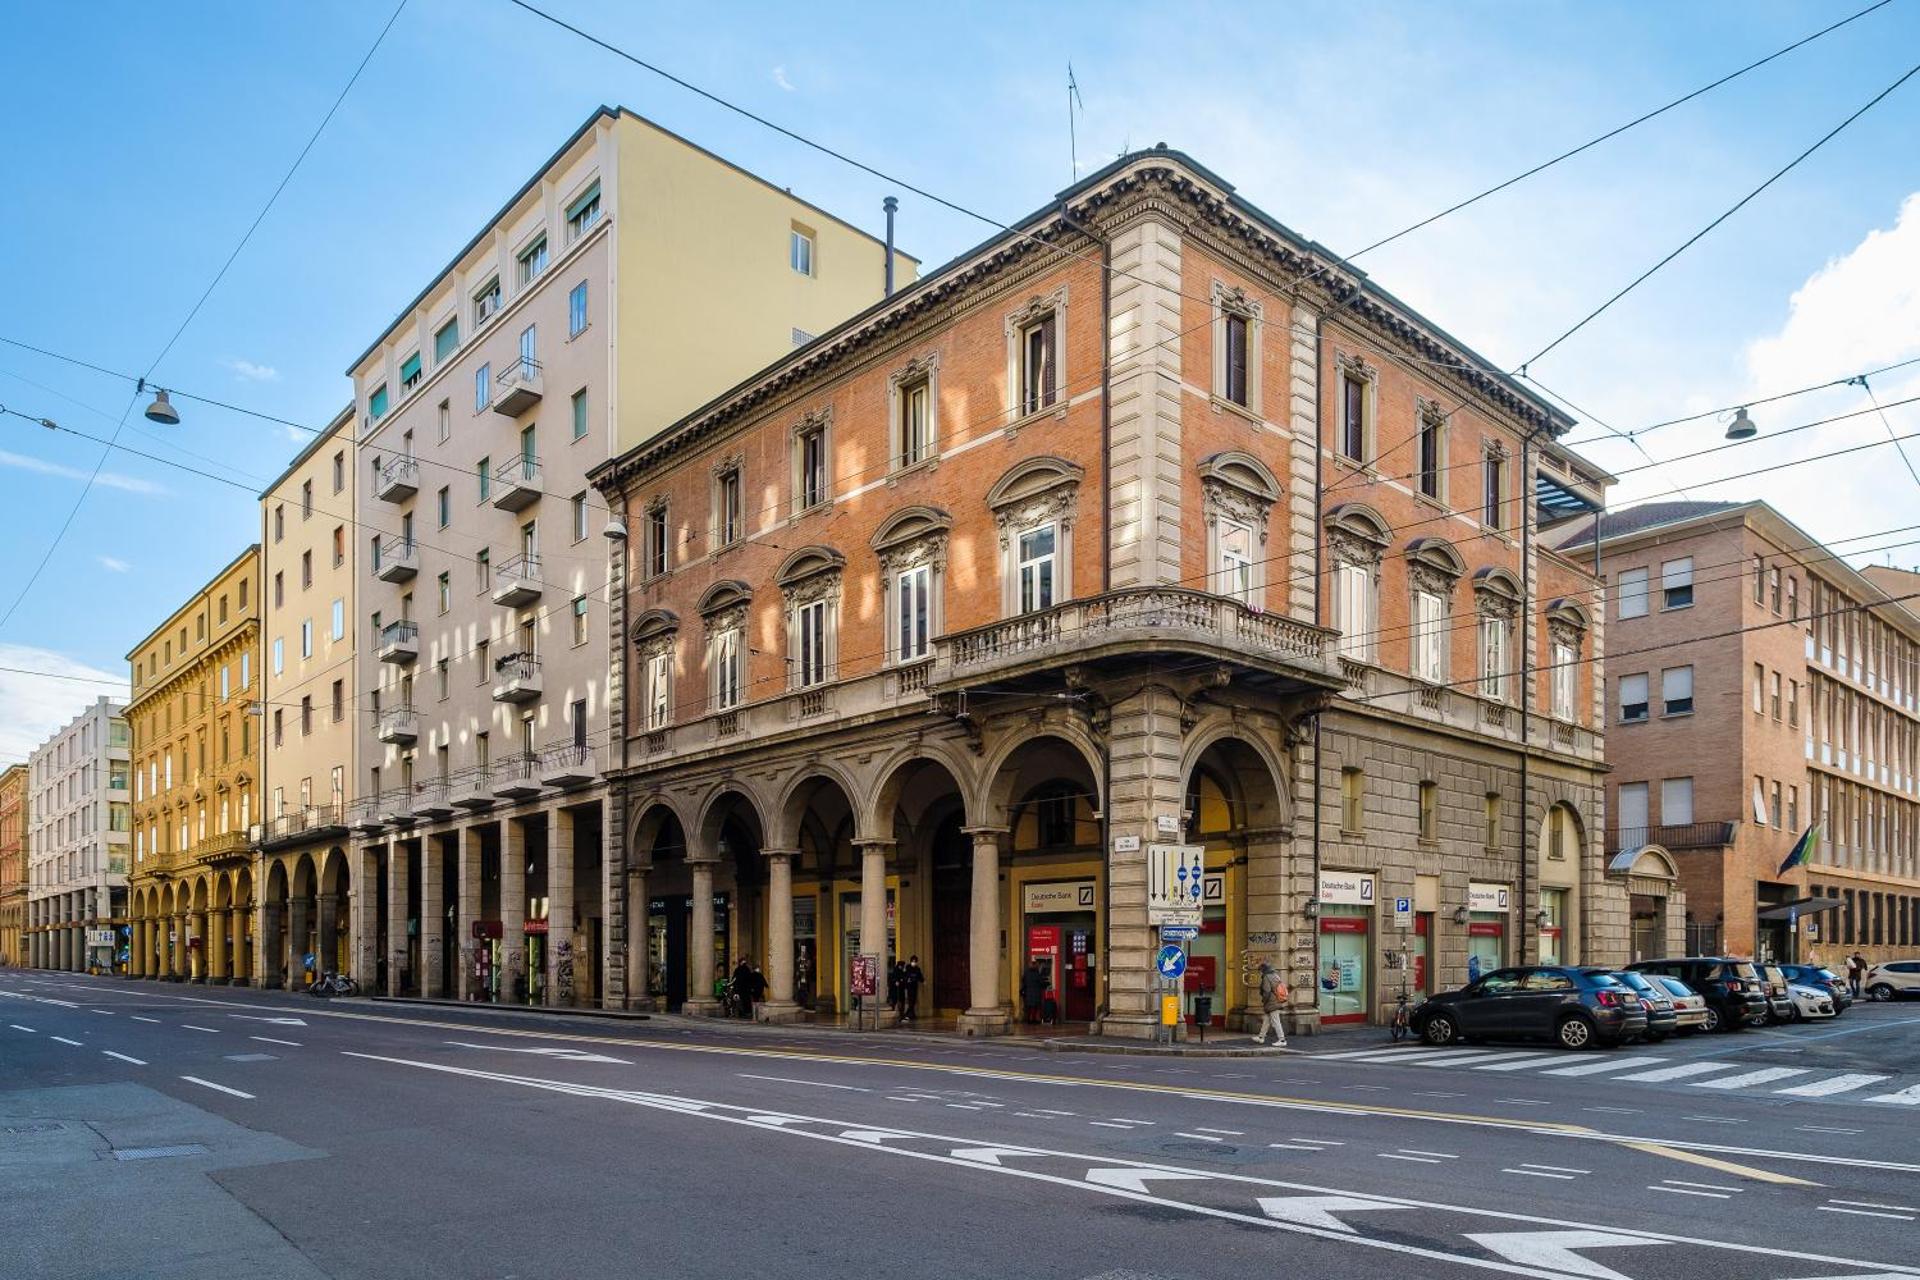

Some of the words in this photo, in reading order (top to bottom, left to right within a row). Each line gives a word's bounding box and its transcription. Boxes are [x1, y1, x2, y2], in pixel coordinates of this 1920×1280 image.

[1344, 882, 1356, 890] Bank
[1031, 892, 1056, 900] Deutsche
[1057, 891, 1072, 900] Bank
[1399, 901, 1407, 910] P
